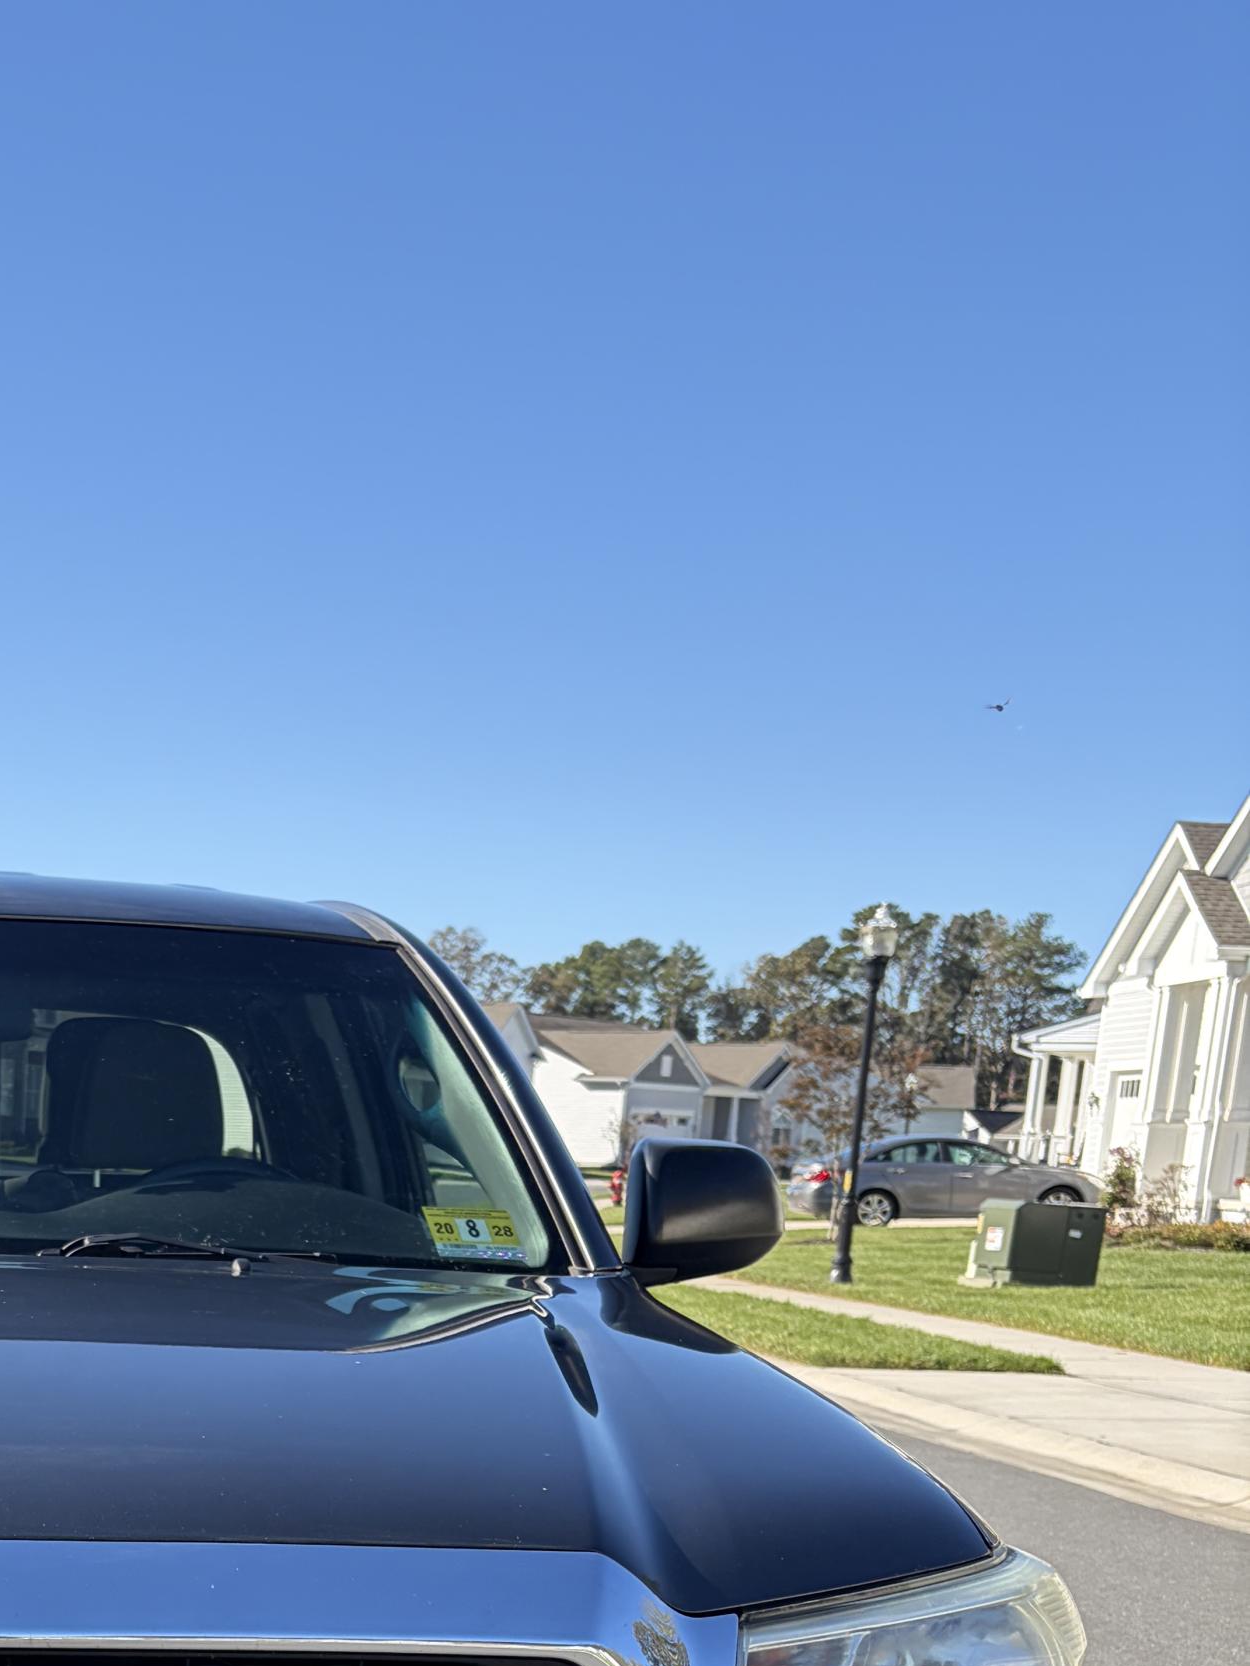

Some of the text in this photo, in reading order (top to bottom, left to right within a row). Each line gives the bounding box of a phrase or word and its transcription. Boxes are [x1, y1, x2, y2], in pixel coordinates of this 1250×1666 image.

[434, 1219, 514, 1238] 20 8 28
